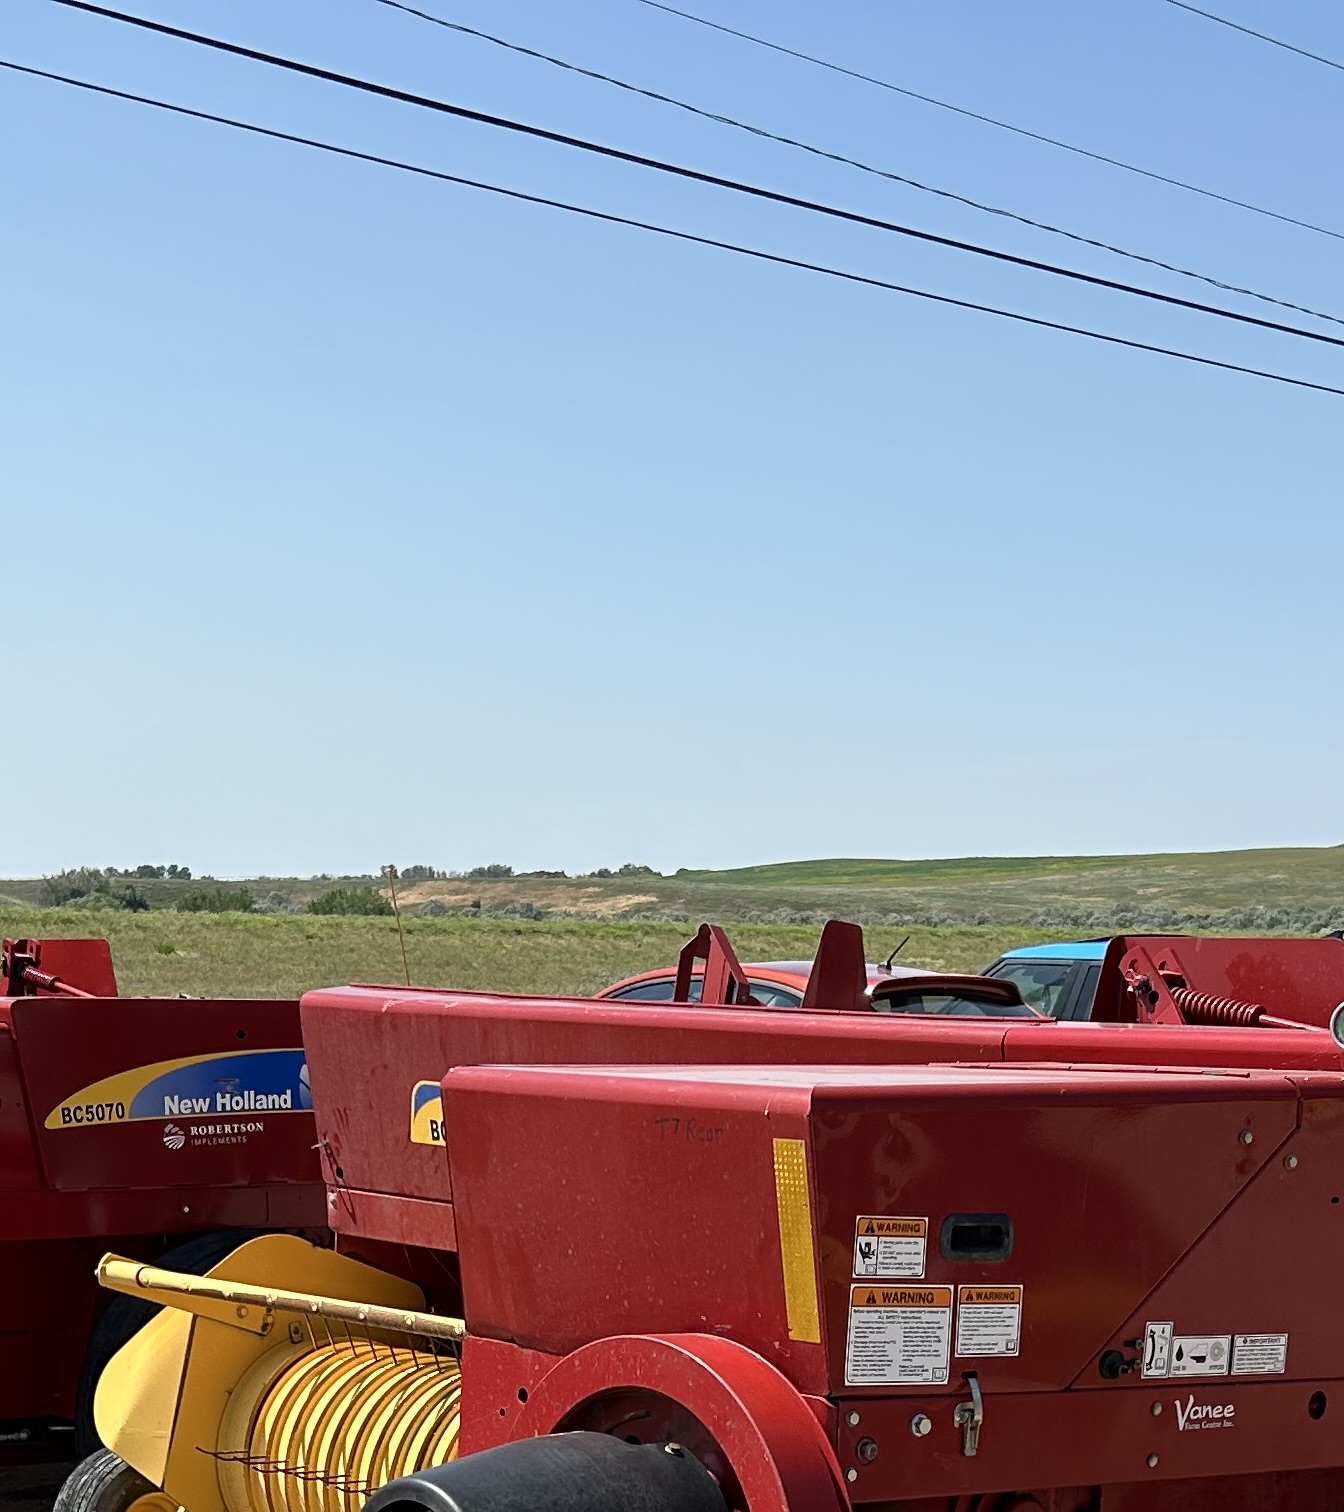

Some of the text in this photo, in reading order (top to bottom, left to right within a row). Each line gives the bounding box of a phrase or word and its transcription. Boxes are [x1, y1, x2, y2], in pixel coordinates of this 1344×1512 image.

[163, 1089, 292, 1116] New Holland
[60, 1102, 125, 1125] BC5070
[190, 1121, 264, 1136] ROBERTSON
[190, 1135, 248, 1147] IMPLEMENTS
[876, 1222, 921, 1233] WARNING
[881, 1291, 935, 1305] WARNING
[975, 1291, 1015, 1301] WARNING
[1174, 1394, 1235, 1432] Vanee
